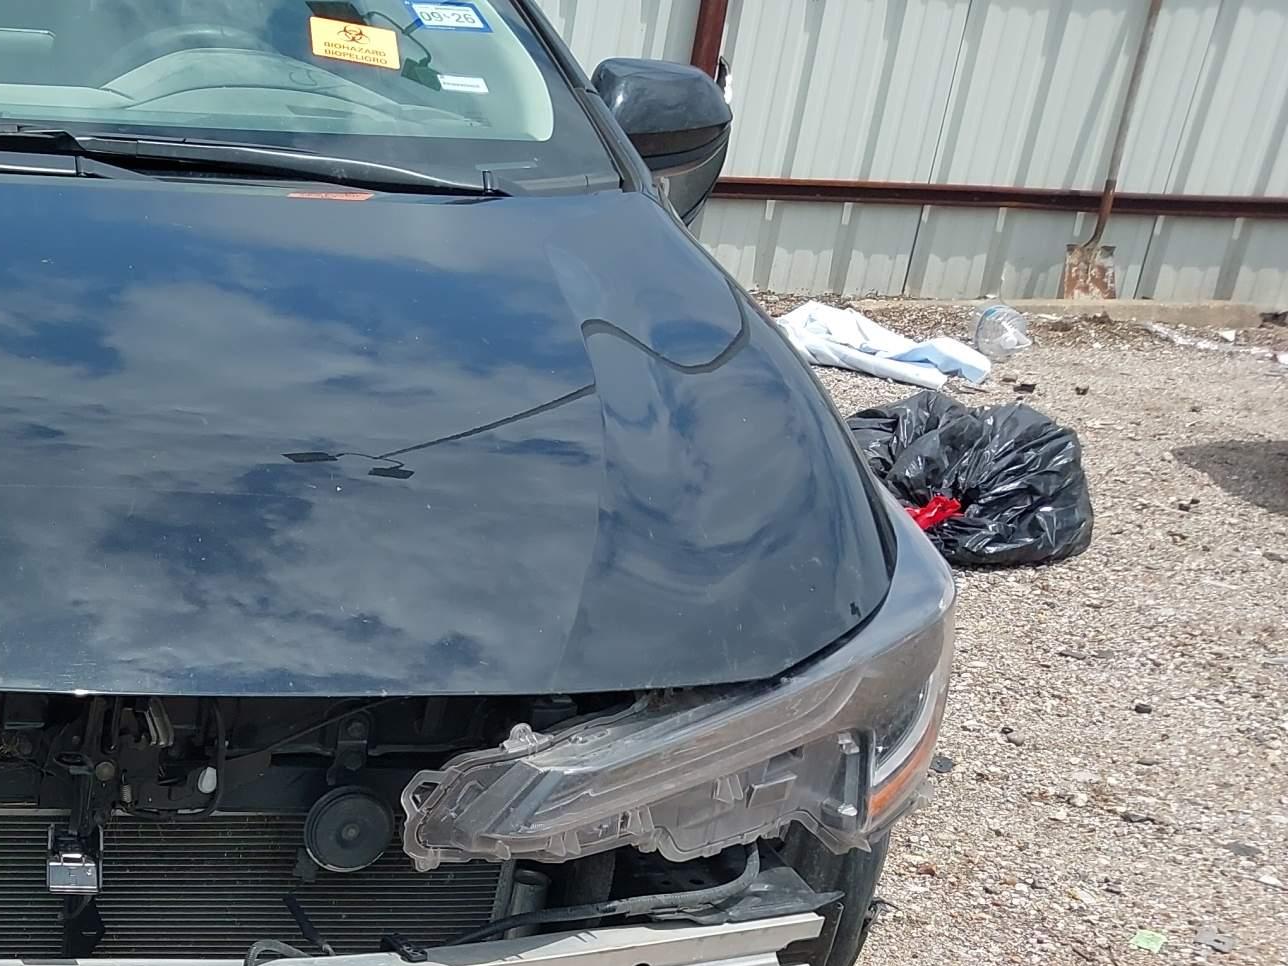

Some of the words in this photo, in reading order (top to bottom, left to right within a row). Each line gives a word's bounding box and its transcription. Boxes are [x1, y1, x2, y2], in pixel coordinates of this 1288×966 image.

[419, 11, 444, 22] 09
[450, 12, 476, 24] 26
[323, 41, 387, 57] BIOHAZARD
[324, 48, 388, 65] BIOPELIGRO
